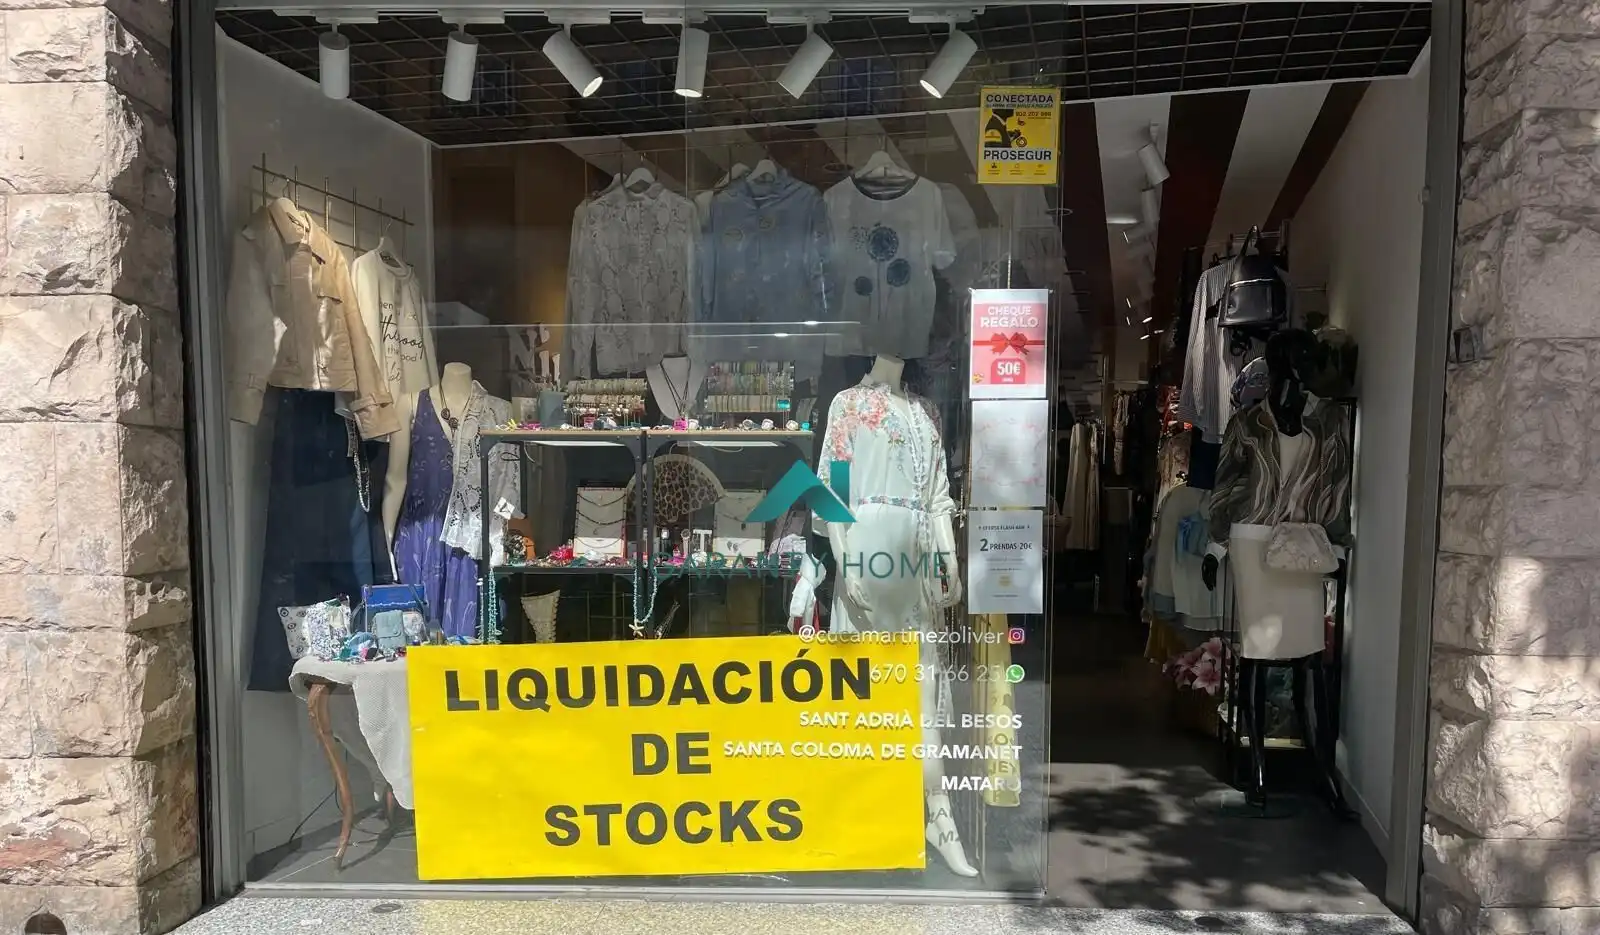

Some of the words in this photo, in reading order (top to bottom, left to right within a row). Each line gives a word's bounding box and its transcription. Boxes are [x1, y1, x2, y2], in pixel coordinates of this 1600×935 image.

[986, 94, 1054, 103] CONECTADA
[983, 150, 1052, 161] PROSEGUR
[987, 305, 1032, 316] CHEQUE
[980, 316, 1039, 328] REGALO
[997, 361, 1021, 376] 50€
[980, 538, 989, 552] 2
[1019, 542, 1033, 550] 20€
[445, 648, 872, 712] LIQUIDACIÓN
[870, 664, 907, 682] 670
[914, 664, 936, 682] 31
[944, 664, 970, 682] 66
[800, 711, 850, 727] SANT
[854, 709, 915, 729] ADRIÀ
[961, 713, 1023, 729] BESOS
[631, 732, 712, 776] DE
[723, 740, 786, 758] SANTA
[790, 741, 875, 760] COLOMA
[881, 743, 906, 759] DE
[912, 744, 1023, 760] GRAMANET
[543, 798, 805, 847] STOCKS
